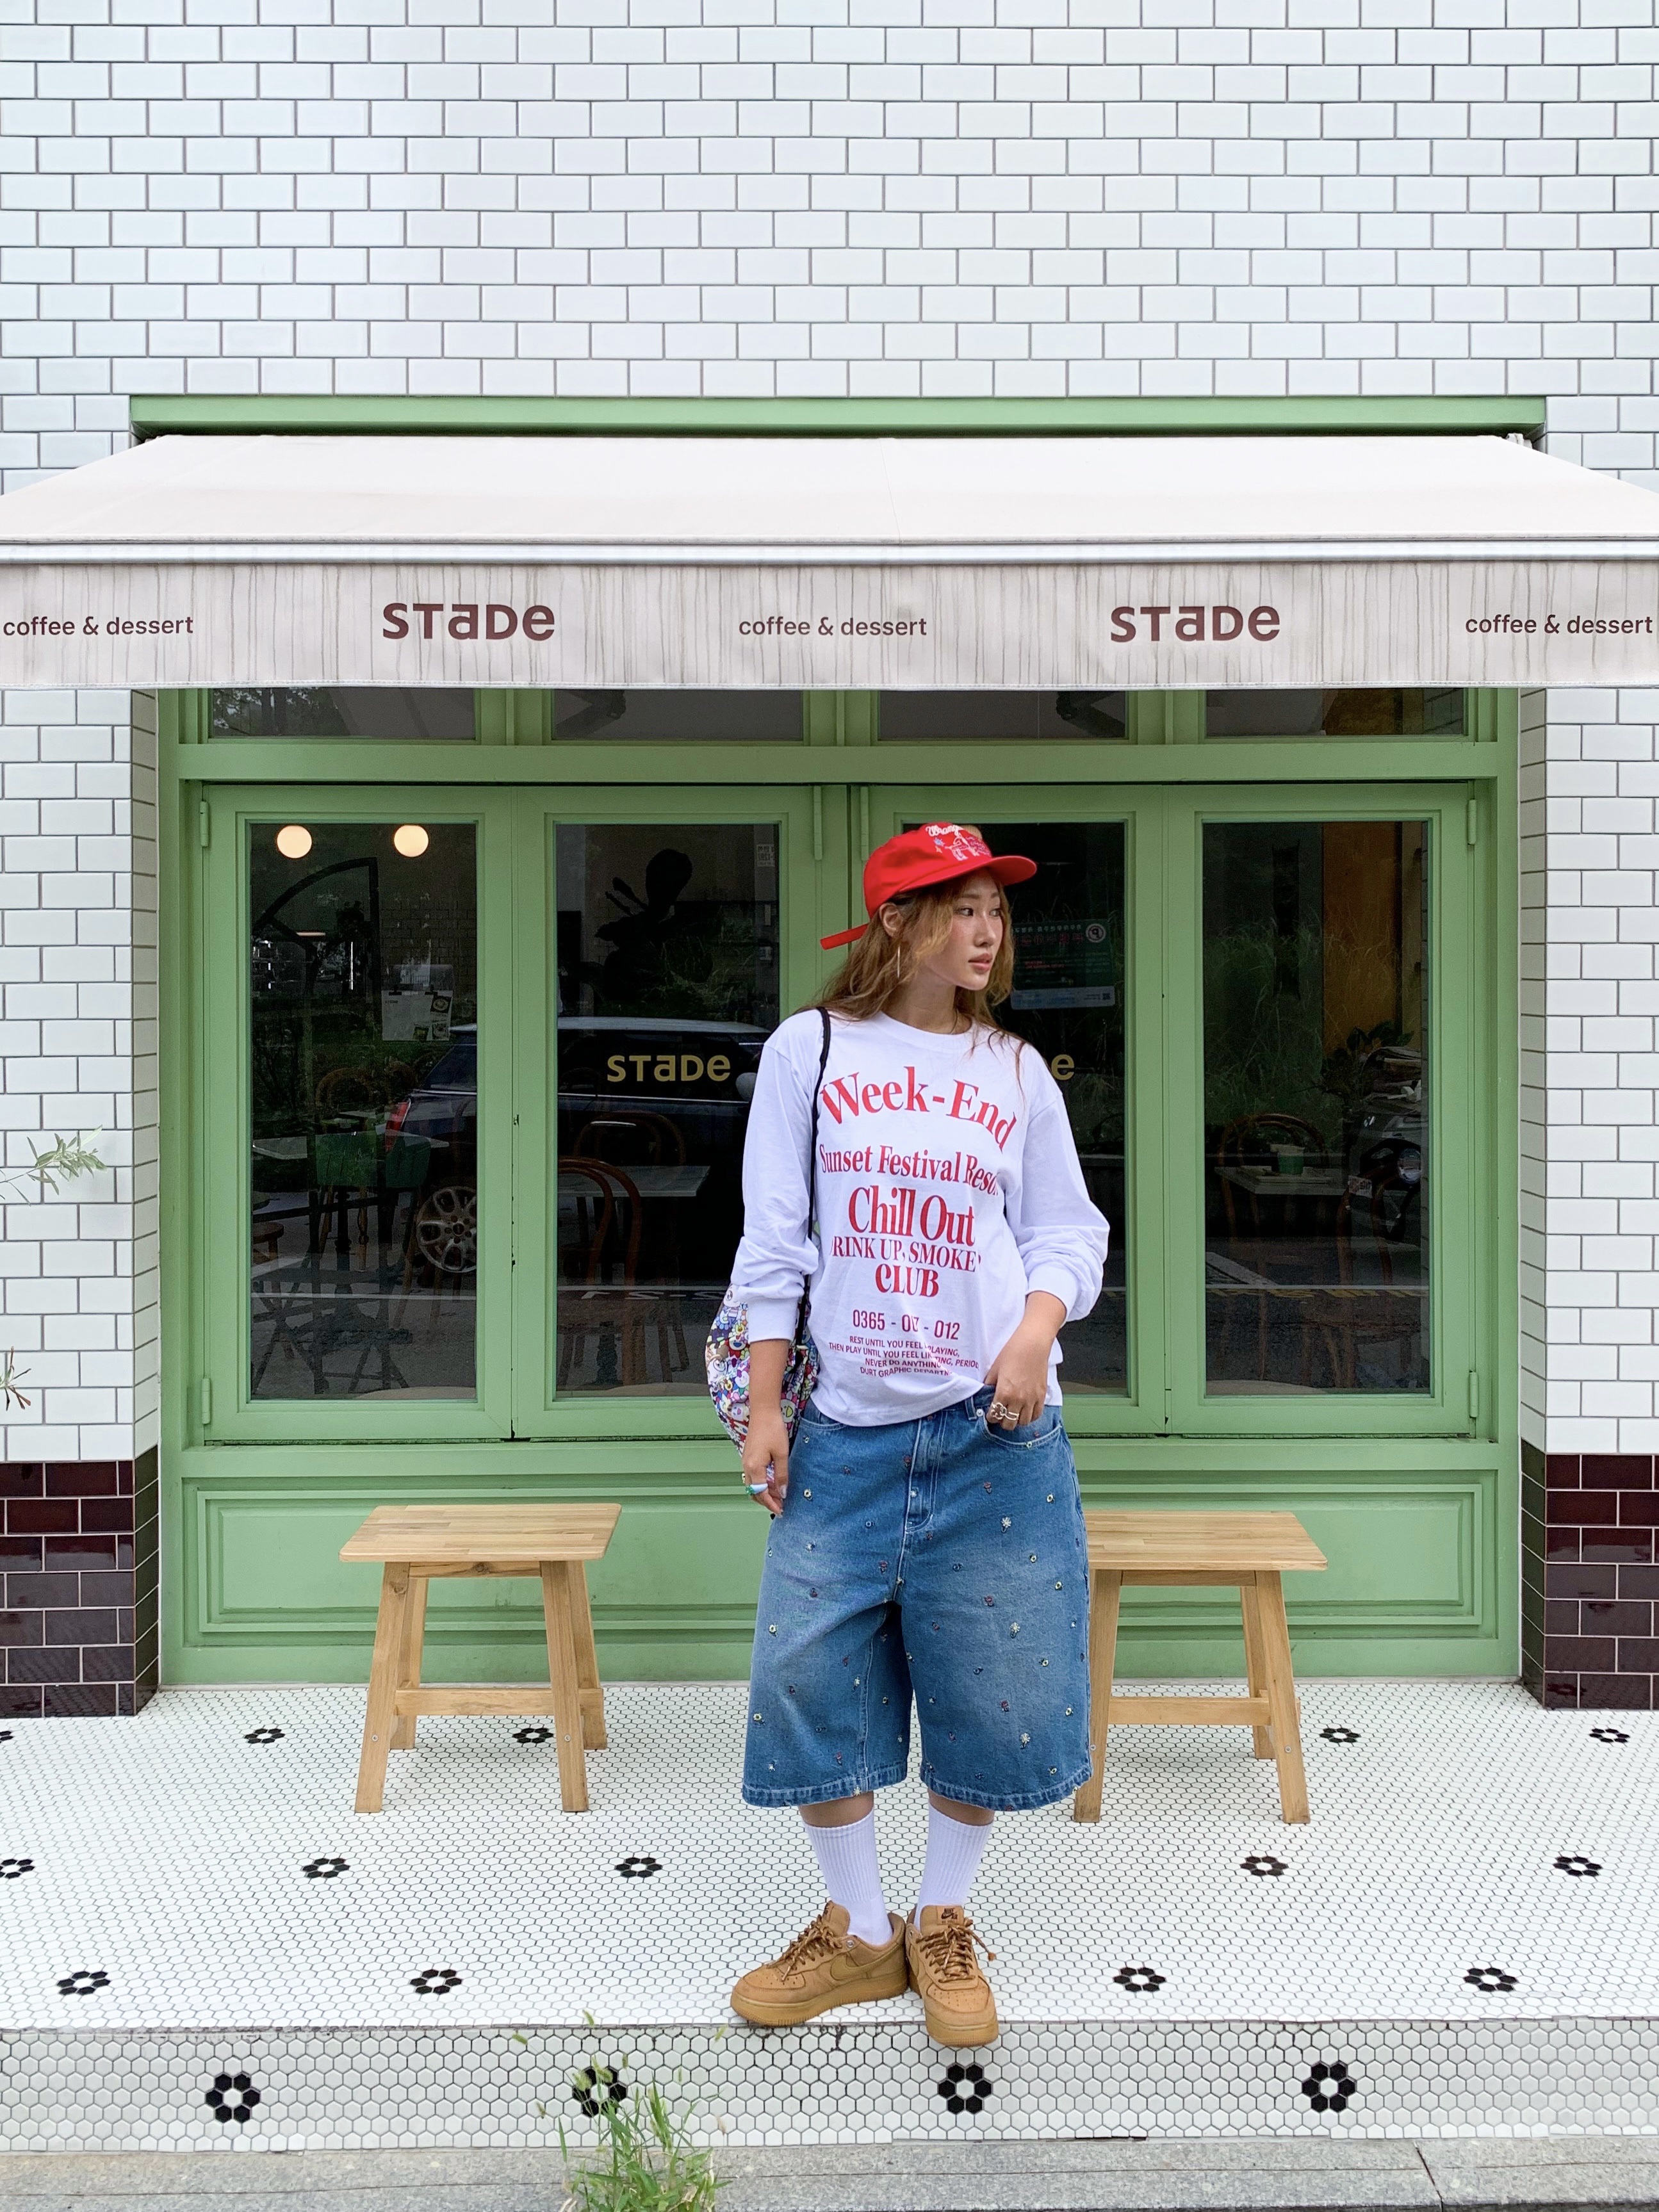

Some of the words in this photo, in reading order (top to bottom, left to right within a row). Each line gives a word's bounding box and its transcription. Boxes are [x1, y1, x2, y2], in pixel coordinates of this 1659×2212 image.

[3, 616, 75, 636] coffee
[83, 616, 99, 635] &
[106, 616, 193, 635] dessert
[739, 616, 810, 635] coffee
[818, 616, 834, 636] &
[840, 617, 927, 636] dessert
[1466, 614, 1537, 633] coffee
[1544, 614, 1560, 634] &
[1567, 615, 1653, 634] dessert
[819, 1066, 1017, 1154] Week-End
[819, 1144, 873, 1173] Sunset
[877, 1144, 961, 1183] Festival
[848, 1185, 917, 1237] Chill
[919, 1194, 976, 1247] Out
[830, 1236, 876, 1259] RINK
[880, 1239, 906, 1263] UP,
[908, 1241, 981, 1273] SMOKE
[875, 1263, 940, 1297] CLUB
[853, 1309, 885, 1331] 0365
[934, 1320, 960, 1340] 012
[829, 1342, 844, 1352] THEN
[846, 1346, 862, 1354] PLAY
[863, 1347, 881, 1358] UNTIL
[883, 1350, 899, 1358] YOU
[849, 1336, 864, 1344] REST
[865, 1338, 885, 1348] UNTIL
[905, 1340, 923, 1349] FEEL
[860, 1367, 876, 1377] DURT
[878, 1367, 912, 1378] GRAPHIC
[865, 1358, 887, 1367] NEVER
